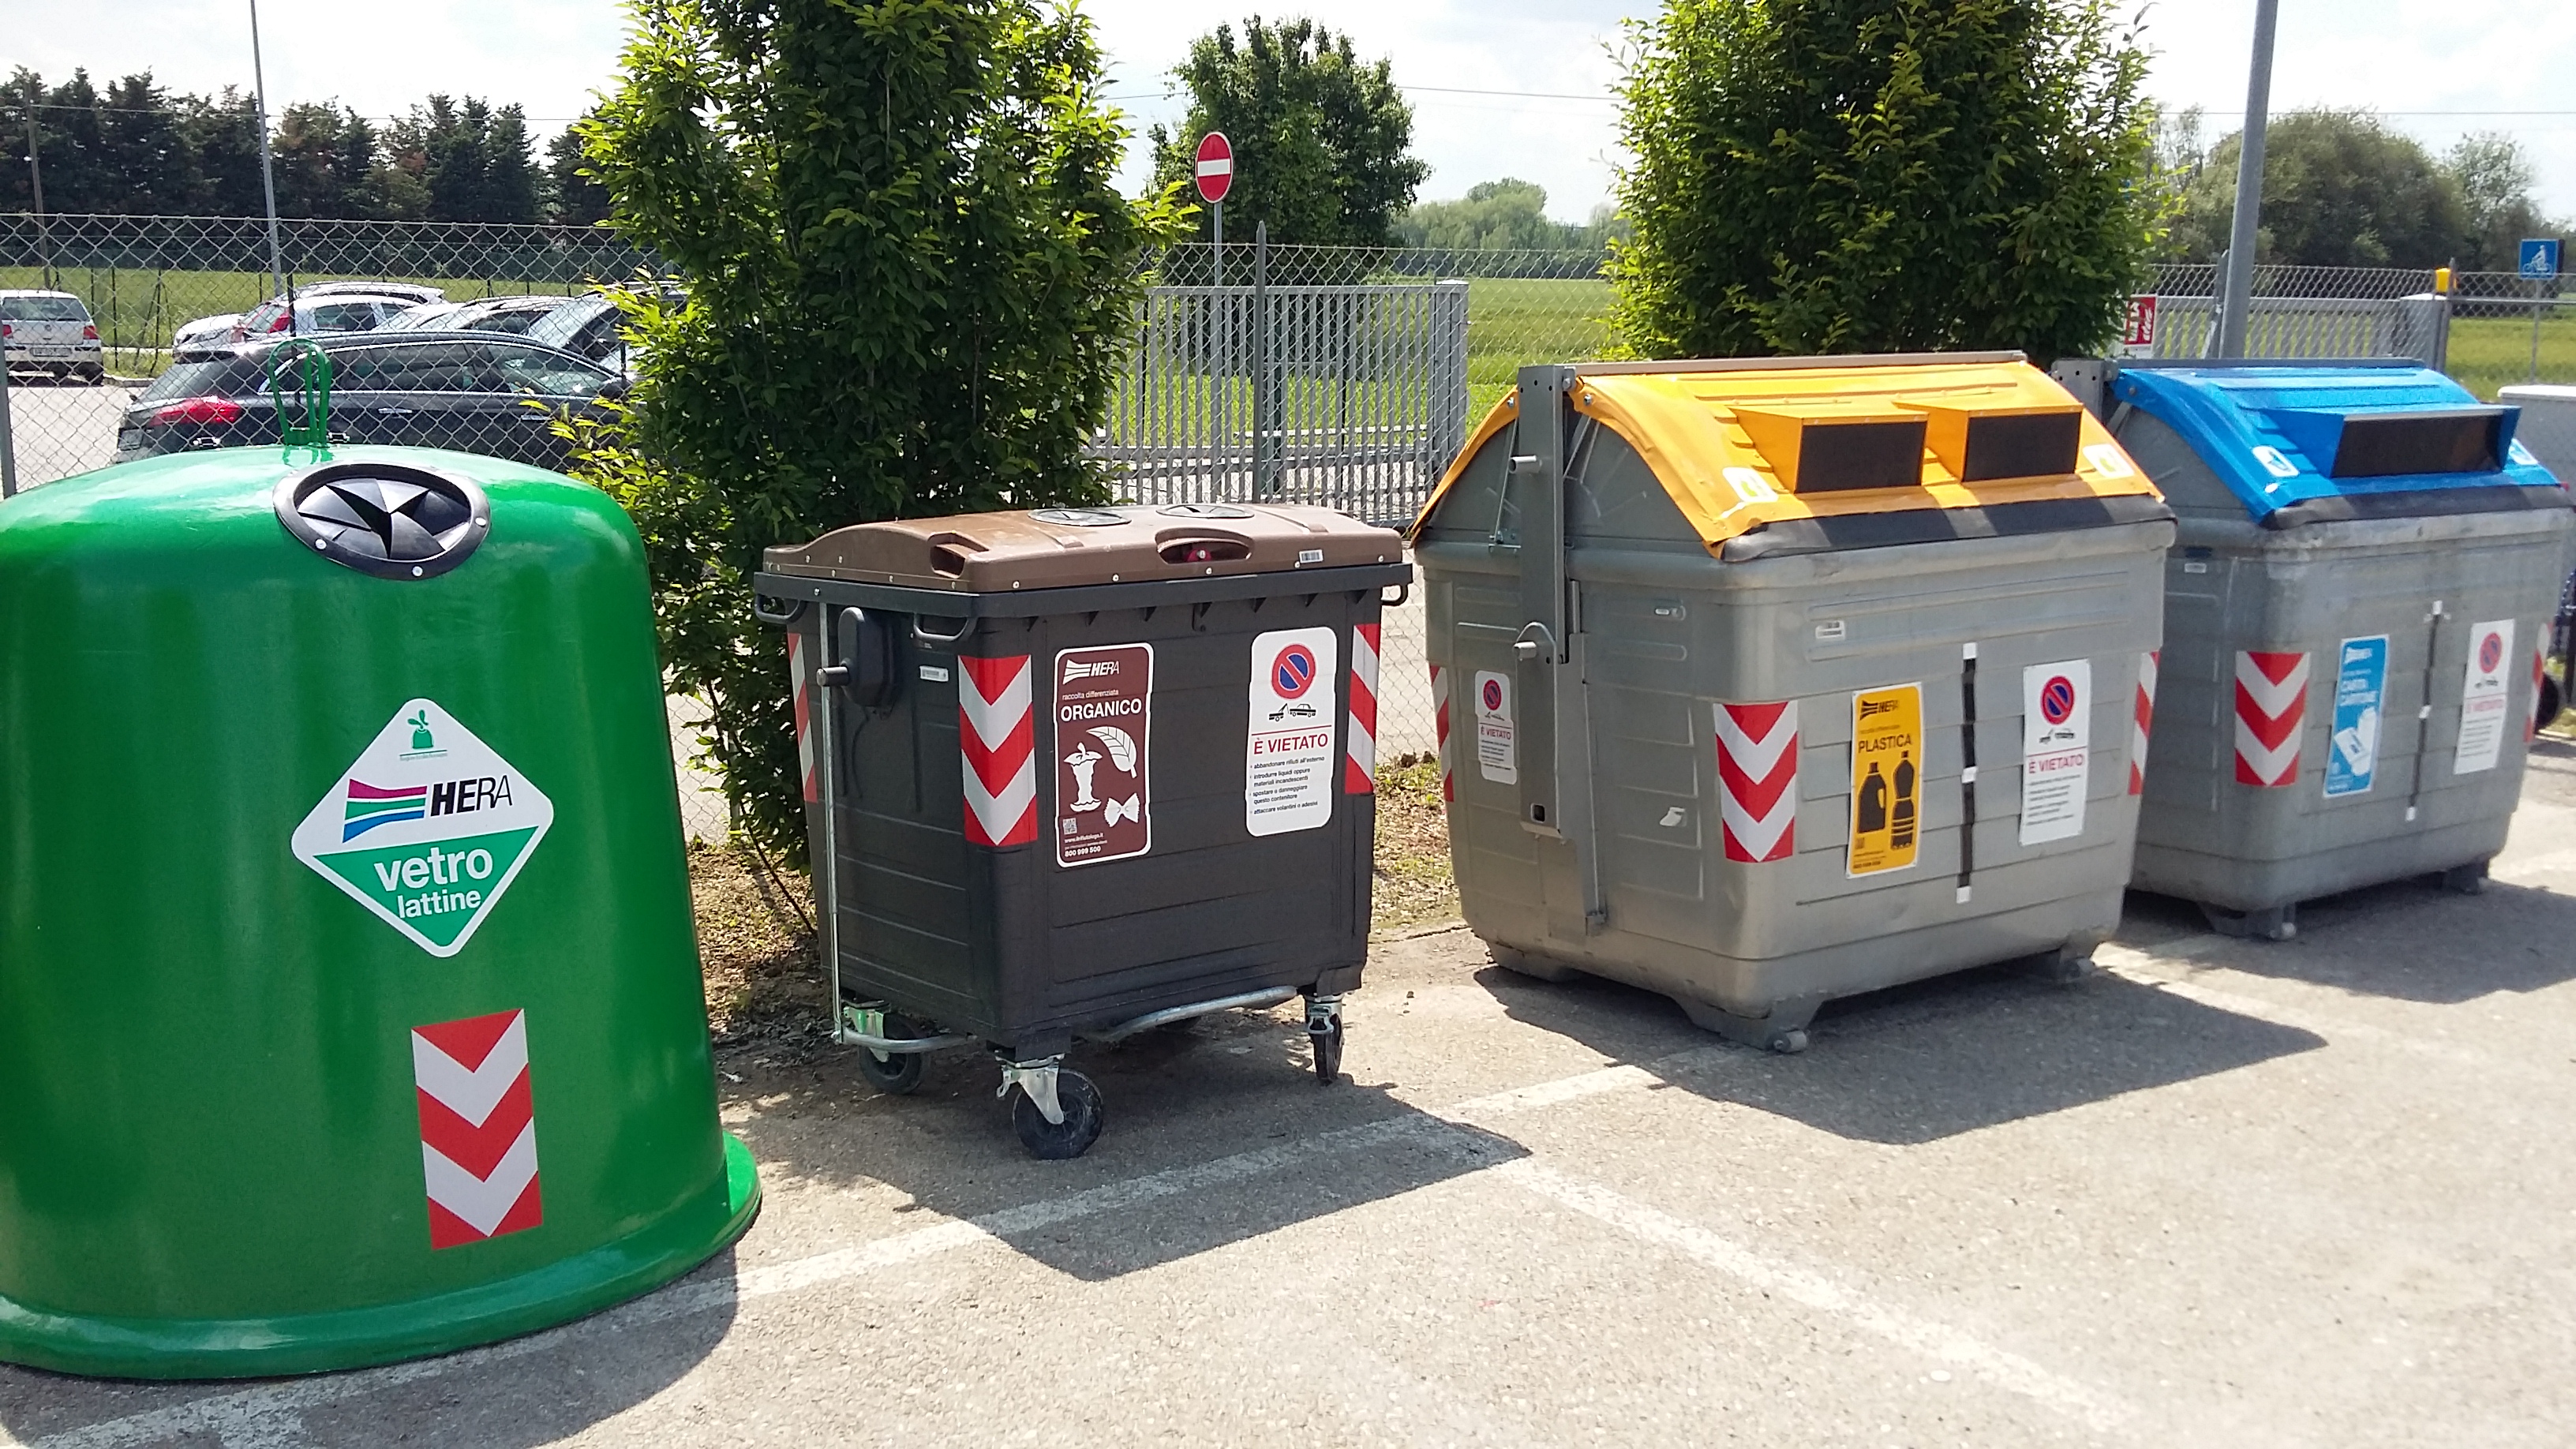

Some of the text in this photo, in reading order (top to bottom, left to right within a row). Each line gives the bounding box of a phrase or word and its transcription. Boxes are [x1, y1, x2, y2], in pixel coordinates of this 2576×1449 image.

[1090, 661, 1120, 676] HERA
[1086, 690, 1119, 698] differenziata
[1061, 698, 1142, 722] ORGANICO
[1254, 733, 1328, 754] È VIETATO
[1486, 728, 1511, 740] VIETATO
[1858, 733, 1912, 754] PLASTICA
[1254, 761, 1286, 769] abbandonare
[2039, 754, 2084, 772] VIETATO
[1254, 776, 1309, 788] materiali incandescenti
[430, 775, 513, 817] HERA
[373, 847, 493, 892] vetro
[397, 889, 482, 919] lattine
